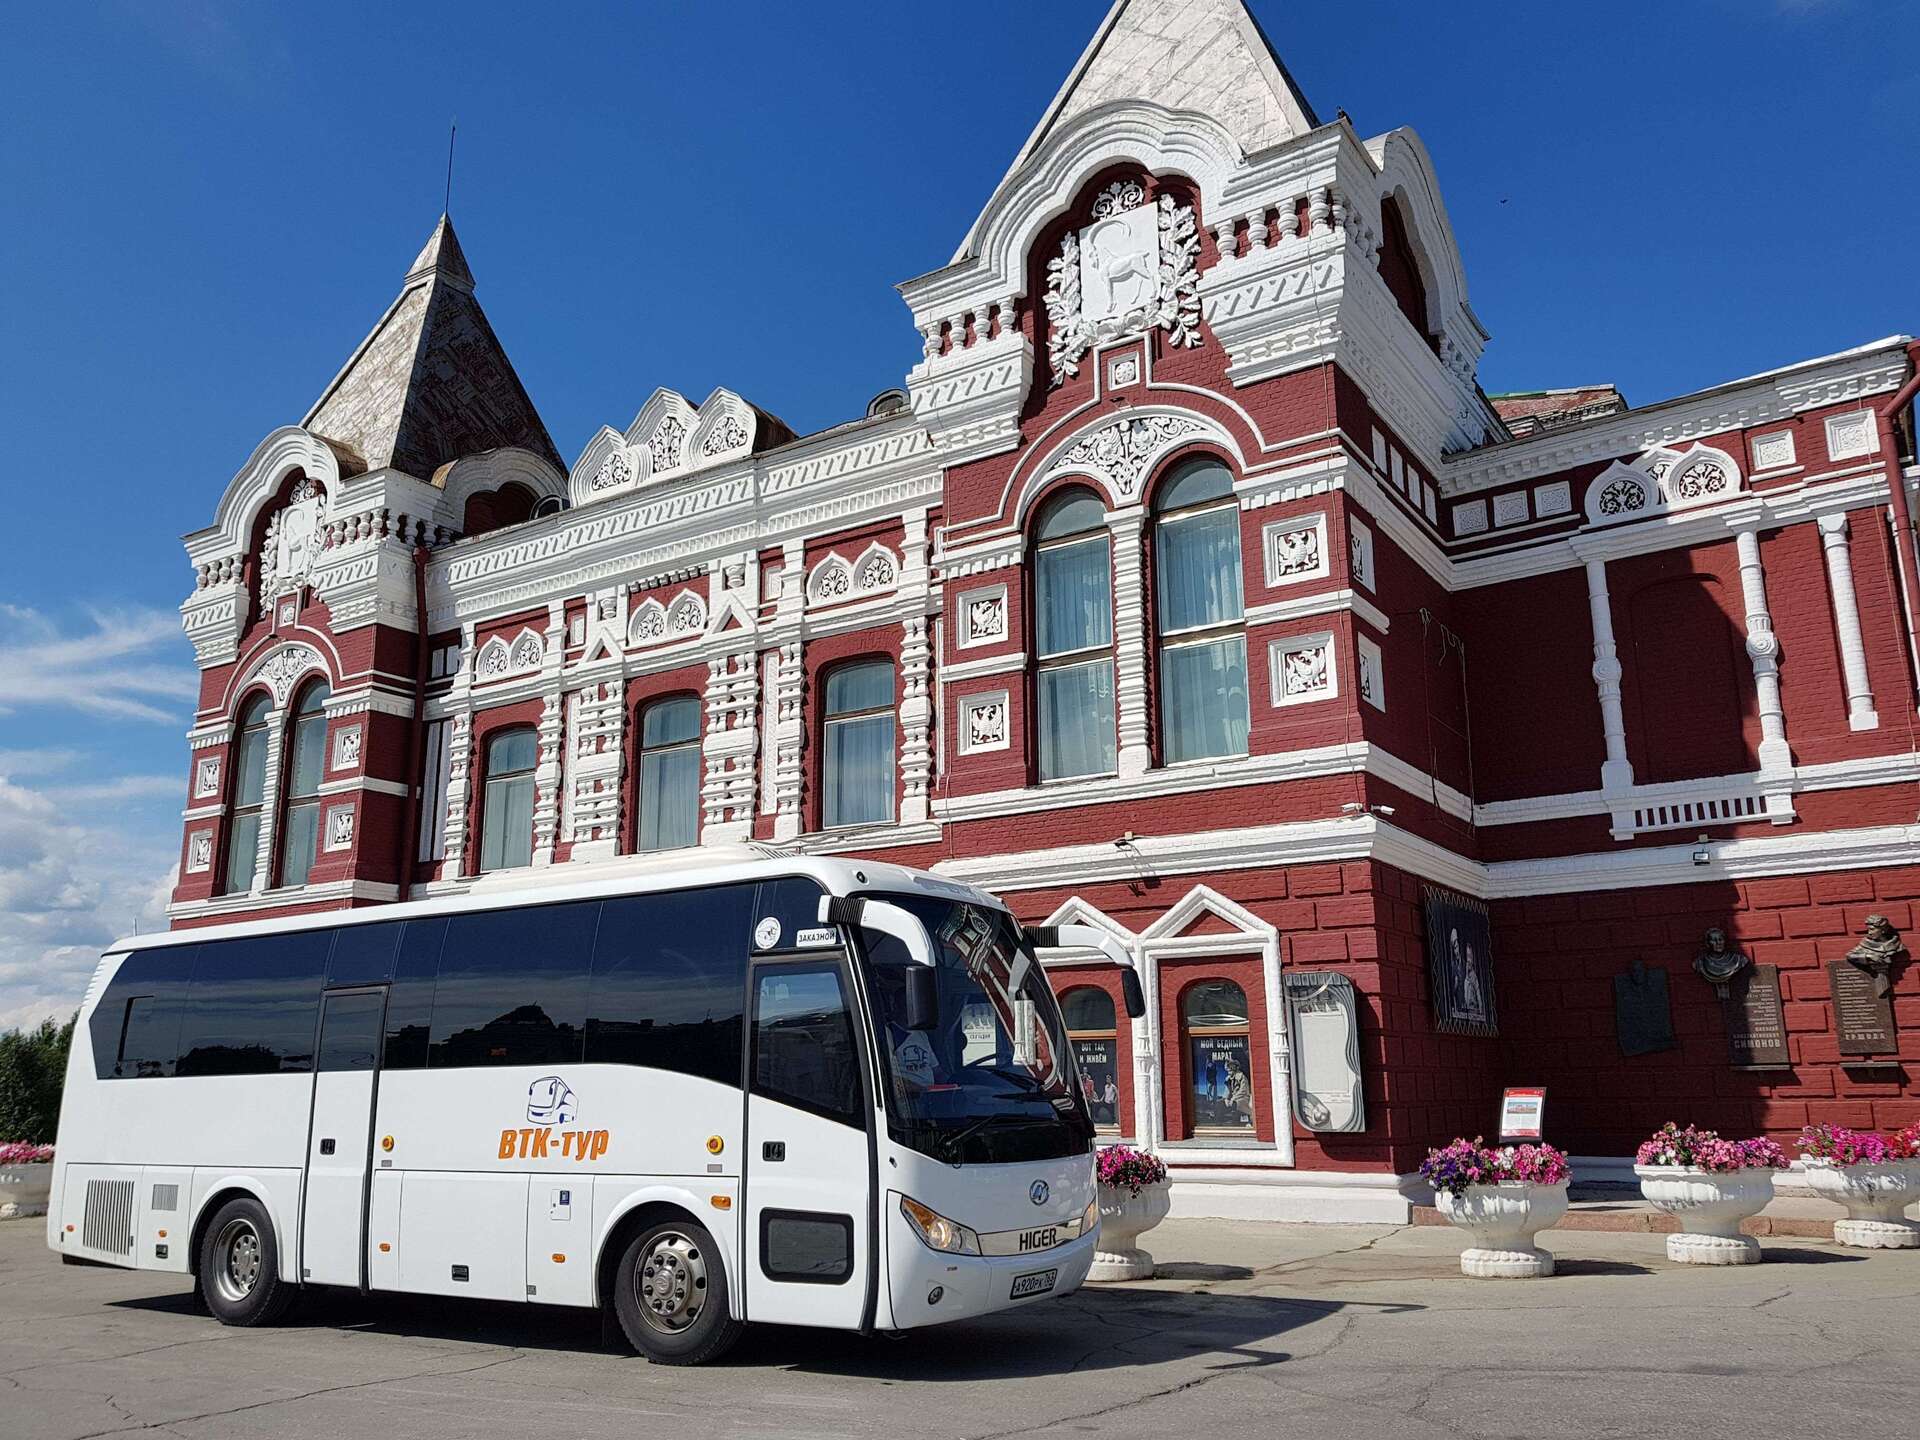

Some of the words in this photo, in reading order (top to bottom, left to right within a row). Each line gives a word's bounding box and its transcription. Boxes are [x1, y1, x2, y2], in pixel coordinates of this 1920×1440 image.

[798, 930, 835, 942] ЗАКАЗНОЙ
[1081, 1042, 1092, 1052] ВОТ
[1094, 1042, 1105, 1052] ТАК
[1200, 1038, 1214, 1048] МОЙ
[1216, 1038, 1243, 1050] БЕДНЫЙ
[1079, 1054, 1084, 1064] И
[1086, 1053, 1107, 1064] ЖИВЁМ
[1212, 1051, 1233, 1061] МАРАТ
[1019, 1227, 1057, 1251] HIGER
